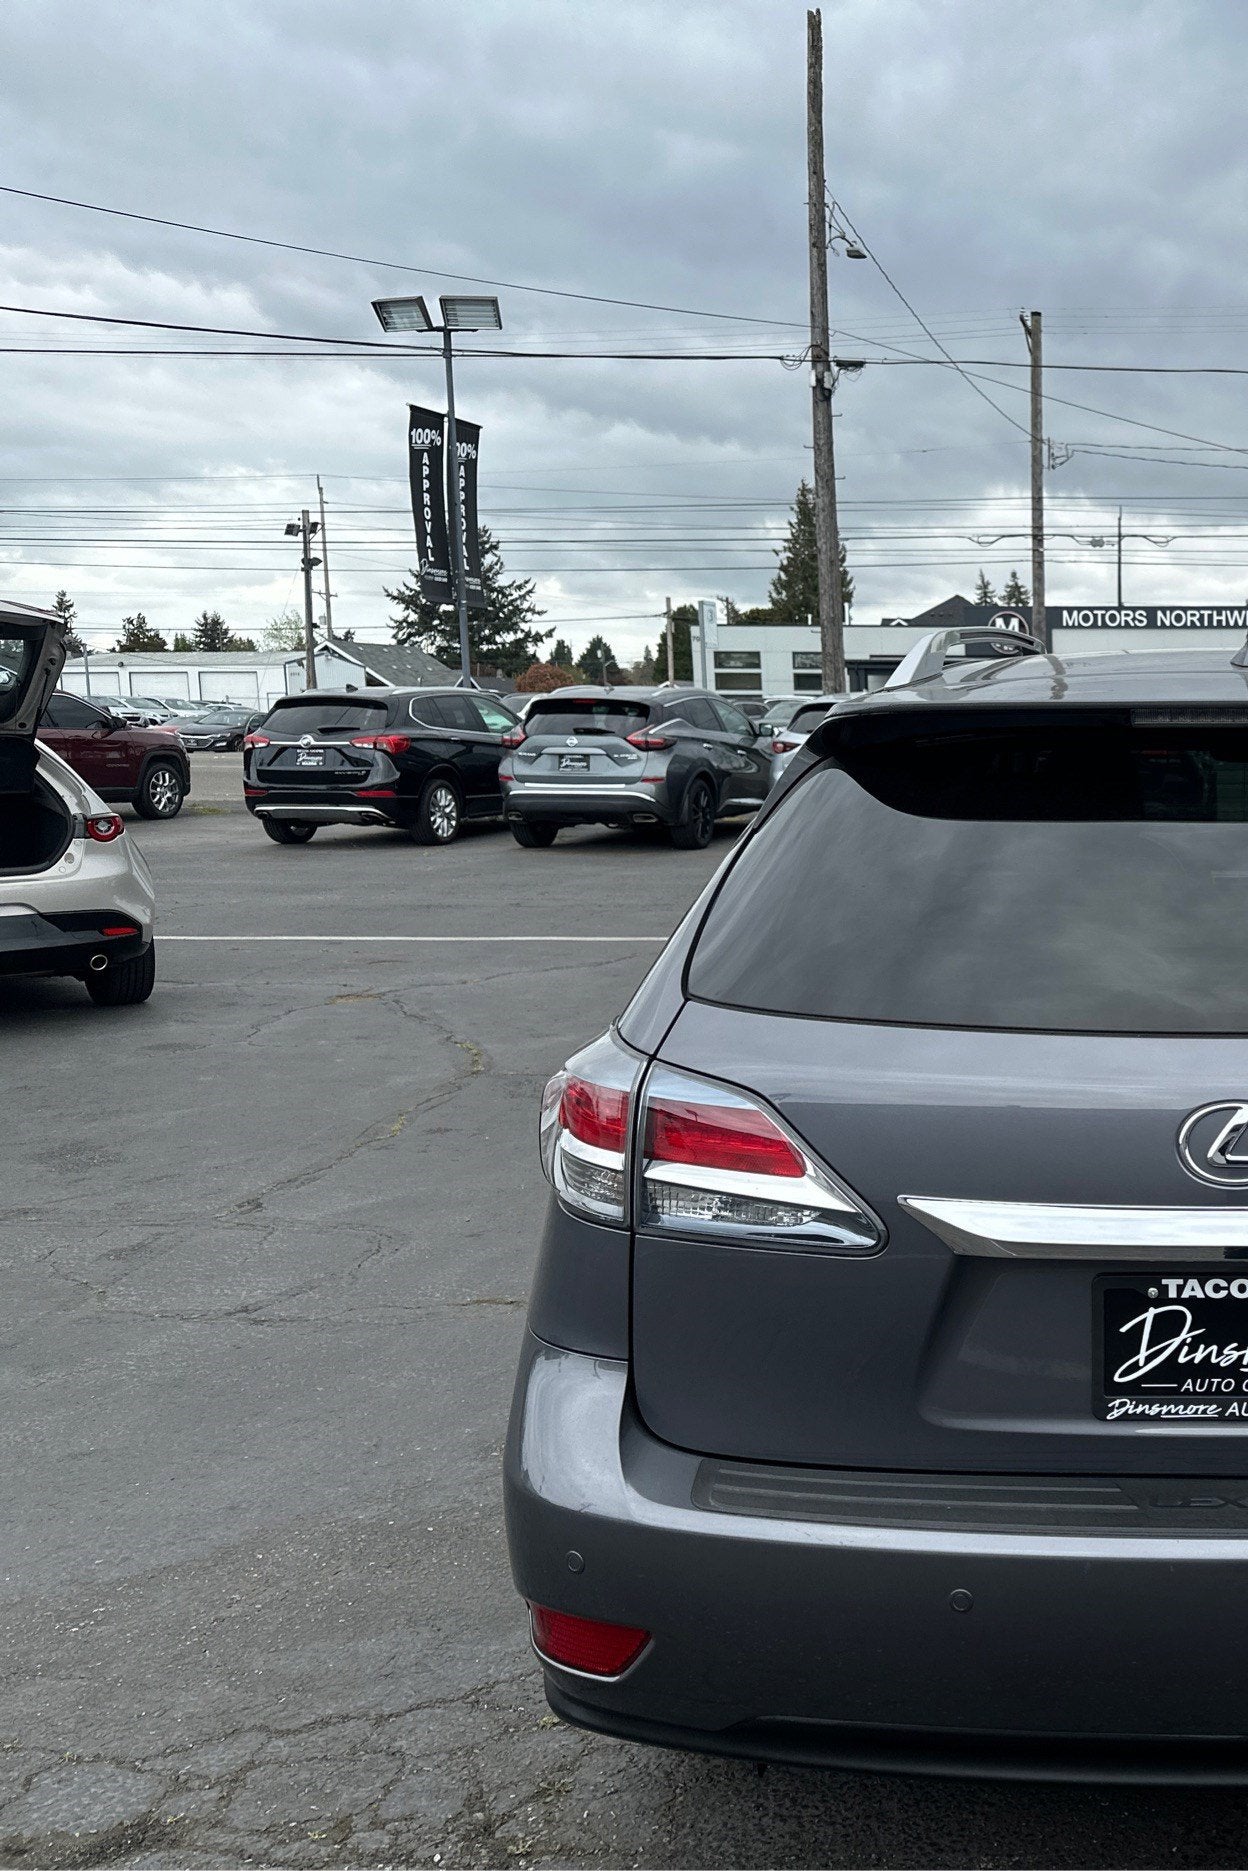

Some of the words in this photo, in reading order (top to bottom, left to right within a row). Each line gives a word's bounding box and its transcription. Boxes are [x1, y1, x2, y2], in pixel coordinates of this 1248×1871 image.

[410, 428, 442, 447] 100%
[422, 452, 435, 562] APPROVAL
[1062, 609, 1147, 627] MOTORS
[1181, 1379, 1235, 1392] AUTO
[1106, 1398, 1222, 1420] Dinsmore
